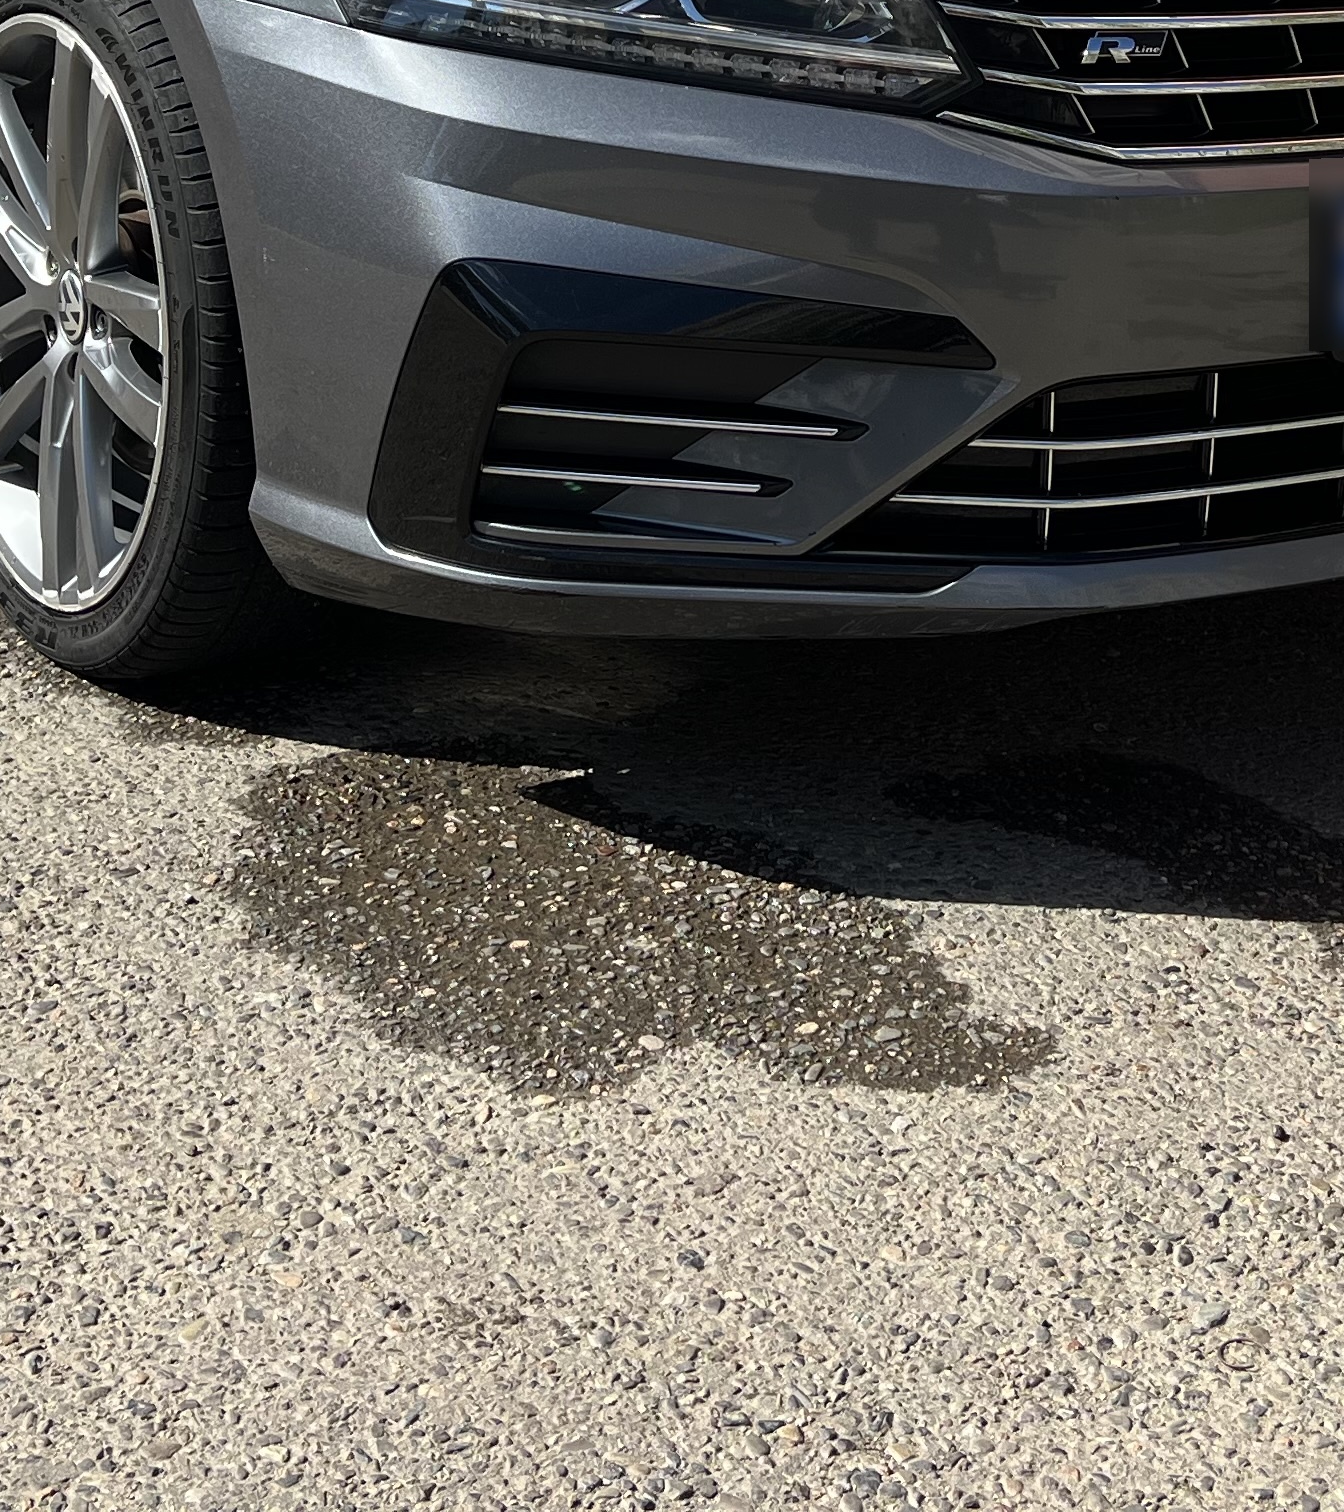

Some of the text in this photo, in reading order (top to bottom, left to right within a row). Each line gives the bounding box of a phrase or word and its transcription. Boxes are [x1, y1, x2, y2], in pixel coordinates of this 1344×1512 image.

[1081, 37, 1161, 64] R Line
[114, 52, 181, 239] WINRUN
